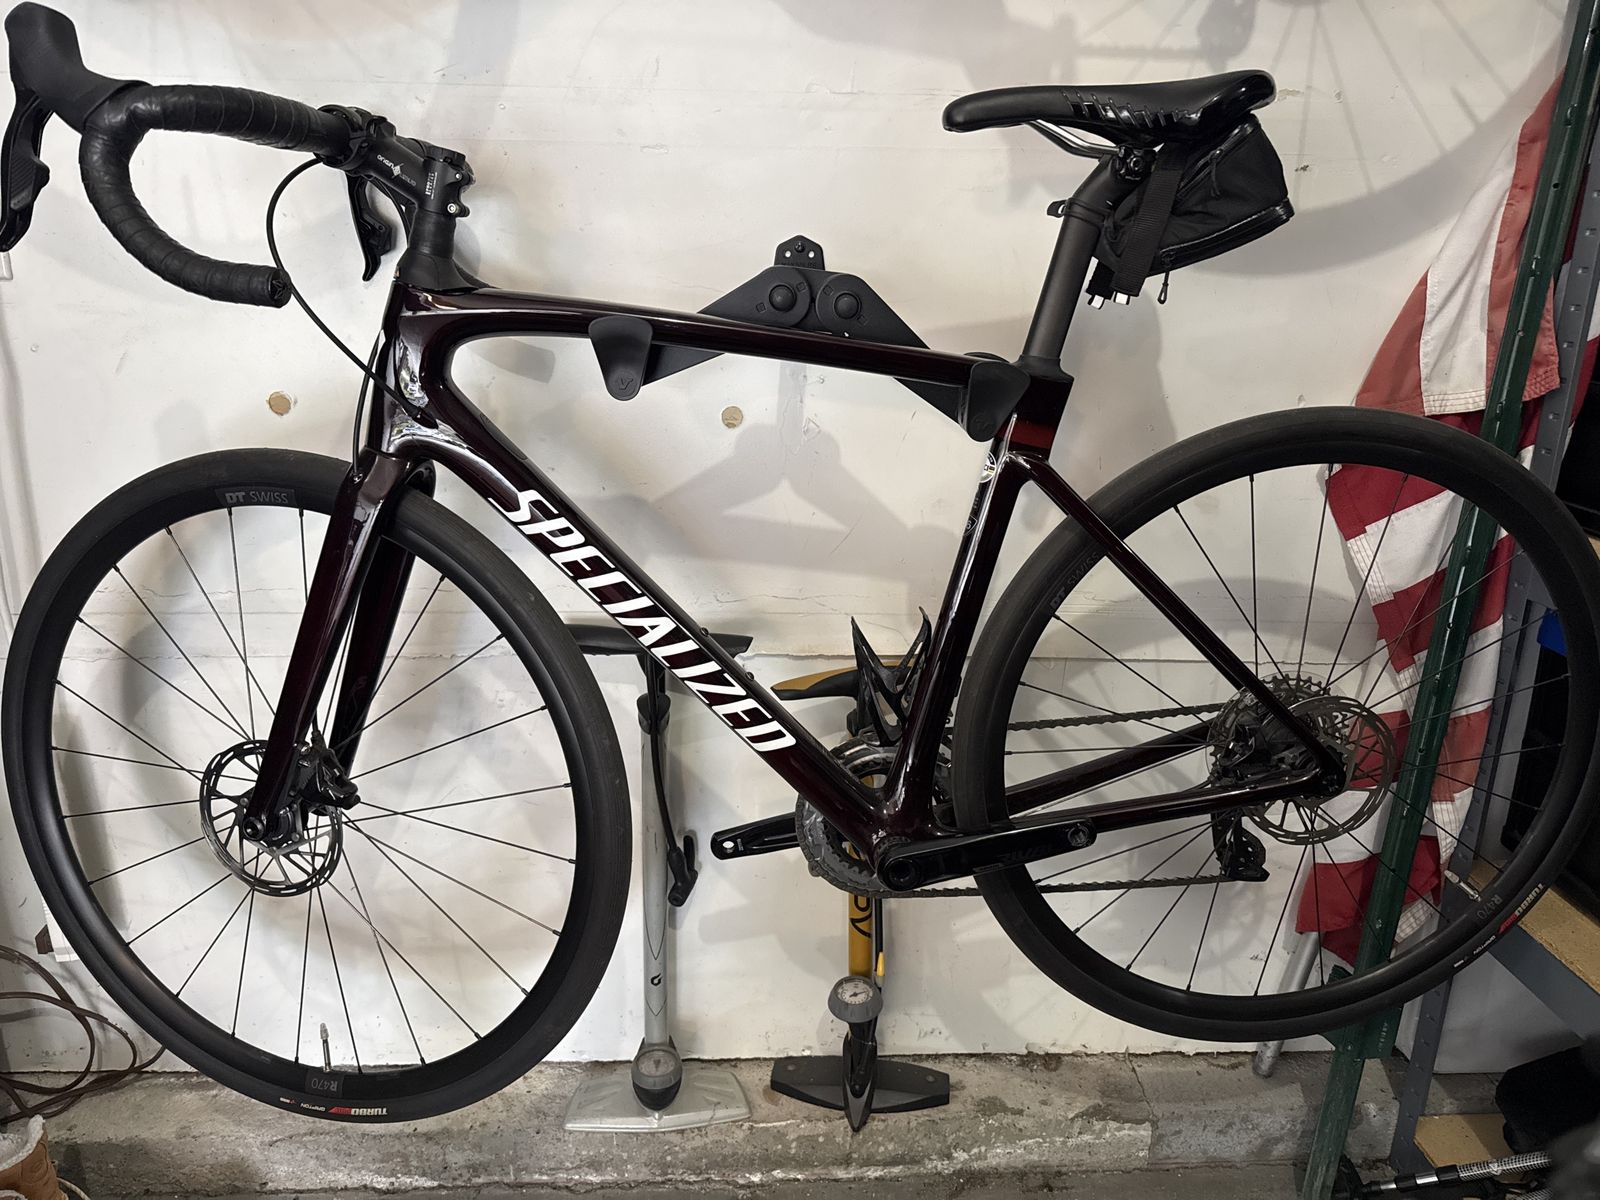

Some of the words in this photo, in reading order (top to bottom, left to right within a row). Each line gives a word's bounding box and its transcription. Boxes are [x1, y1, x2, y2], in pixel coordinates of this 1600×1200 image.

[225, 491, 246, 504] DT
[249, 490, 289, 504] SWISS
[488, 489, 796, 752] SPECIALIZED
[1514, 883, 1545, 916] TURBO
[311, 1078, 338, 1092] R470
[351, 1107, 388, 1116] TURBO
